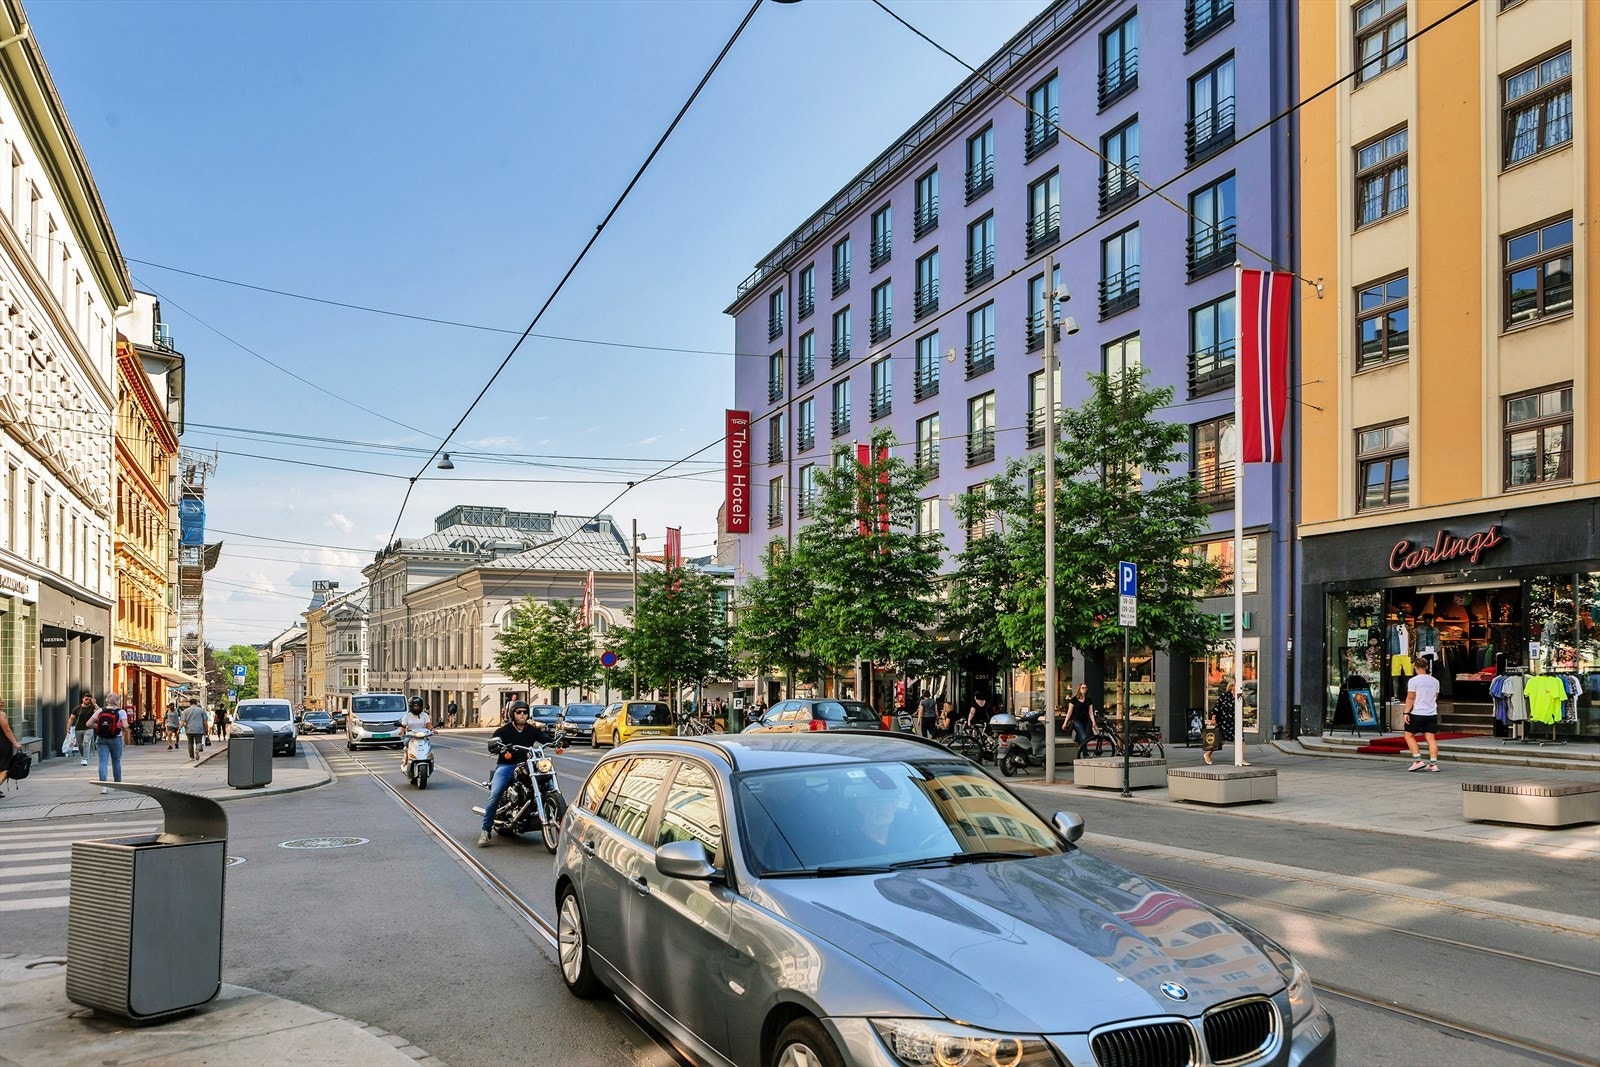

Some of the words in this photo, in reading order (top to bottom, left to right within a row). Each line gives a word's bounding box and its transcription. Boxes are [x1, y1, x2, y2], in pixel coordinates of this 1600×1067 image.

[732, 428, 746, 468] Thon
[732, 474, 746, 525] Hotels
[1389, 524, 1501, 572] Carlings
[1124, 566, 1133, 592] P
[236, 666, 244, 675] P
[735, 699, 743, 708] P
